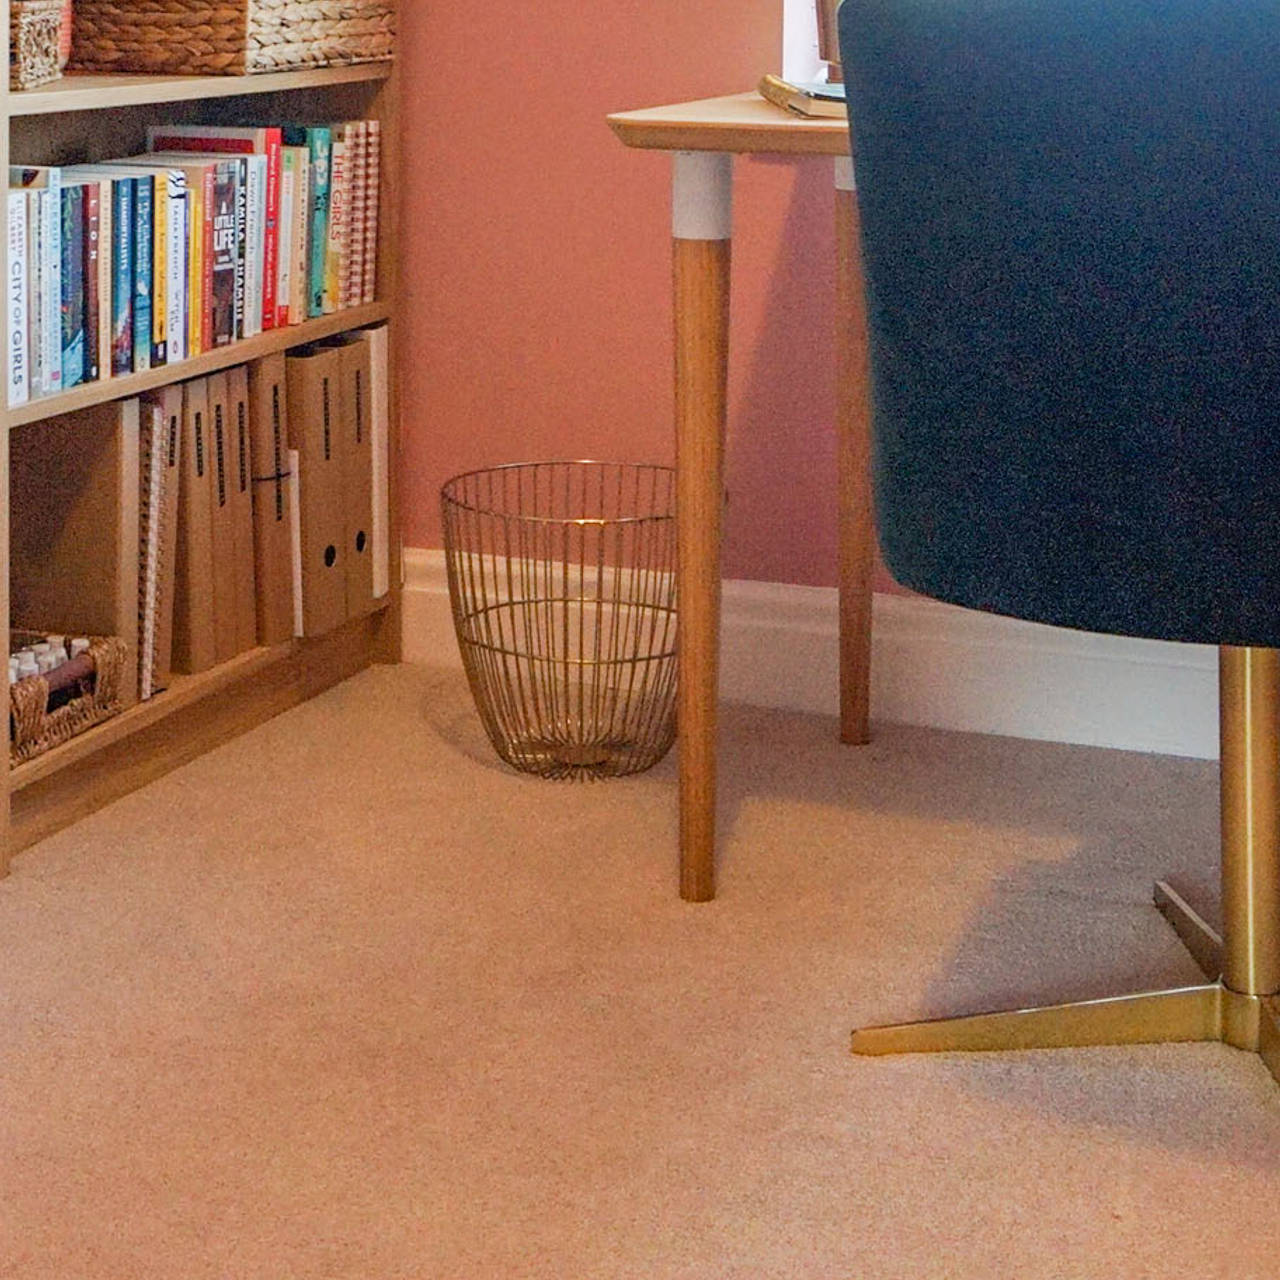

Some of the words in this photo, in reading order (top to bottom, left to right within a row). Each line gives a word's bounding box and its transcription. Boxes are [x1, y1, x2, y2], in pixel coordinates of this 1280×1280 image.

[333, 153, 344, 184] THE
[214, 215, 234, 229] LITTLE
[221, 201, 227, 214] A
[331, 189, 342, 241] GIRLS
[214, 229, 234, 251] LIFE
[11, 261, 22, 304] CITY
[236, 257, 244, 320] SHAMSIE
[13, 306, 22, 328] OF
[12, 330, 23, 386] GIRLS
